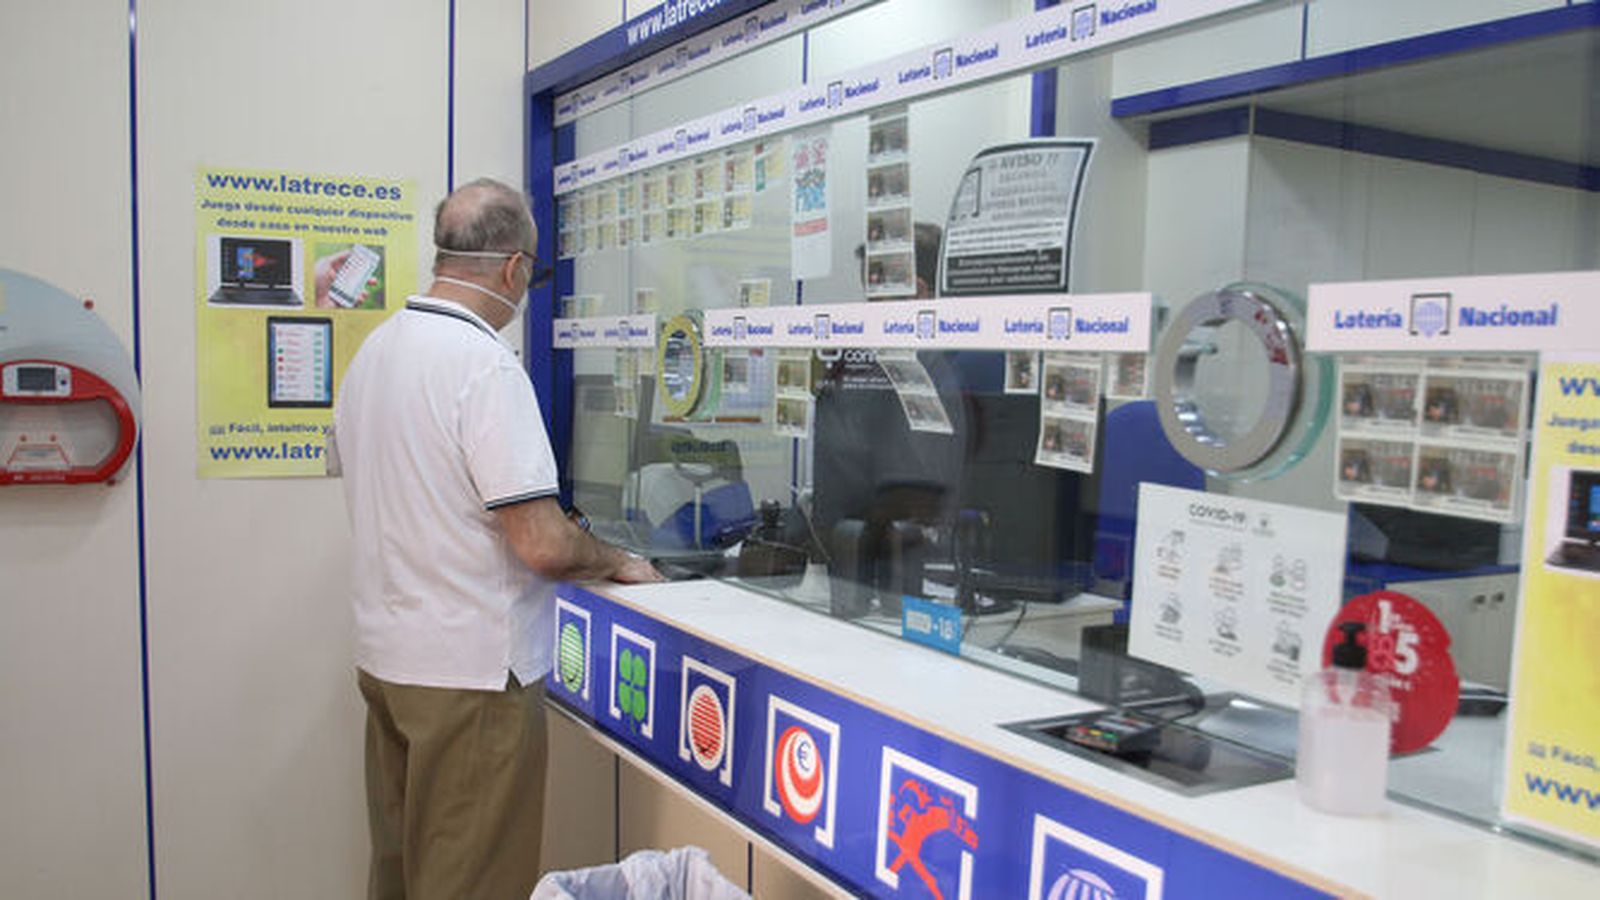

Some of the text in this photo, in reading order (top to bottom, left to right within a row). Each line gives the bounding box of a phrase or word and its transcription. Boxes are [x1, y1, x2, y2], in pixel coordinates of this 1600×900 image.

[1100, 0, 1157, 25] Nacional
[956, 44, 999, 67] Nacional
[206, 173, 402, 201] www.latrece.es
[201, 199, 414, 222] Juega desde cualquier dispositivo
[216, 217, 256, 230] desde
[293, 223, 310, 232] en
[363, 226, 388, 237] web
[938, 317, 980, 334] Nacional
[1074, 315, 1130, 334] Nacional
[1335, 303, 1559, 329] Lotería Nacional
[209, 441, 327, 460] www.latr
[1396, 631, 1419, 675] 5
